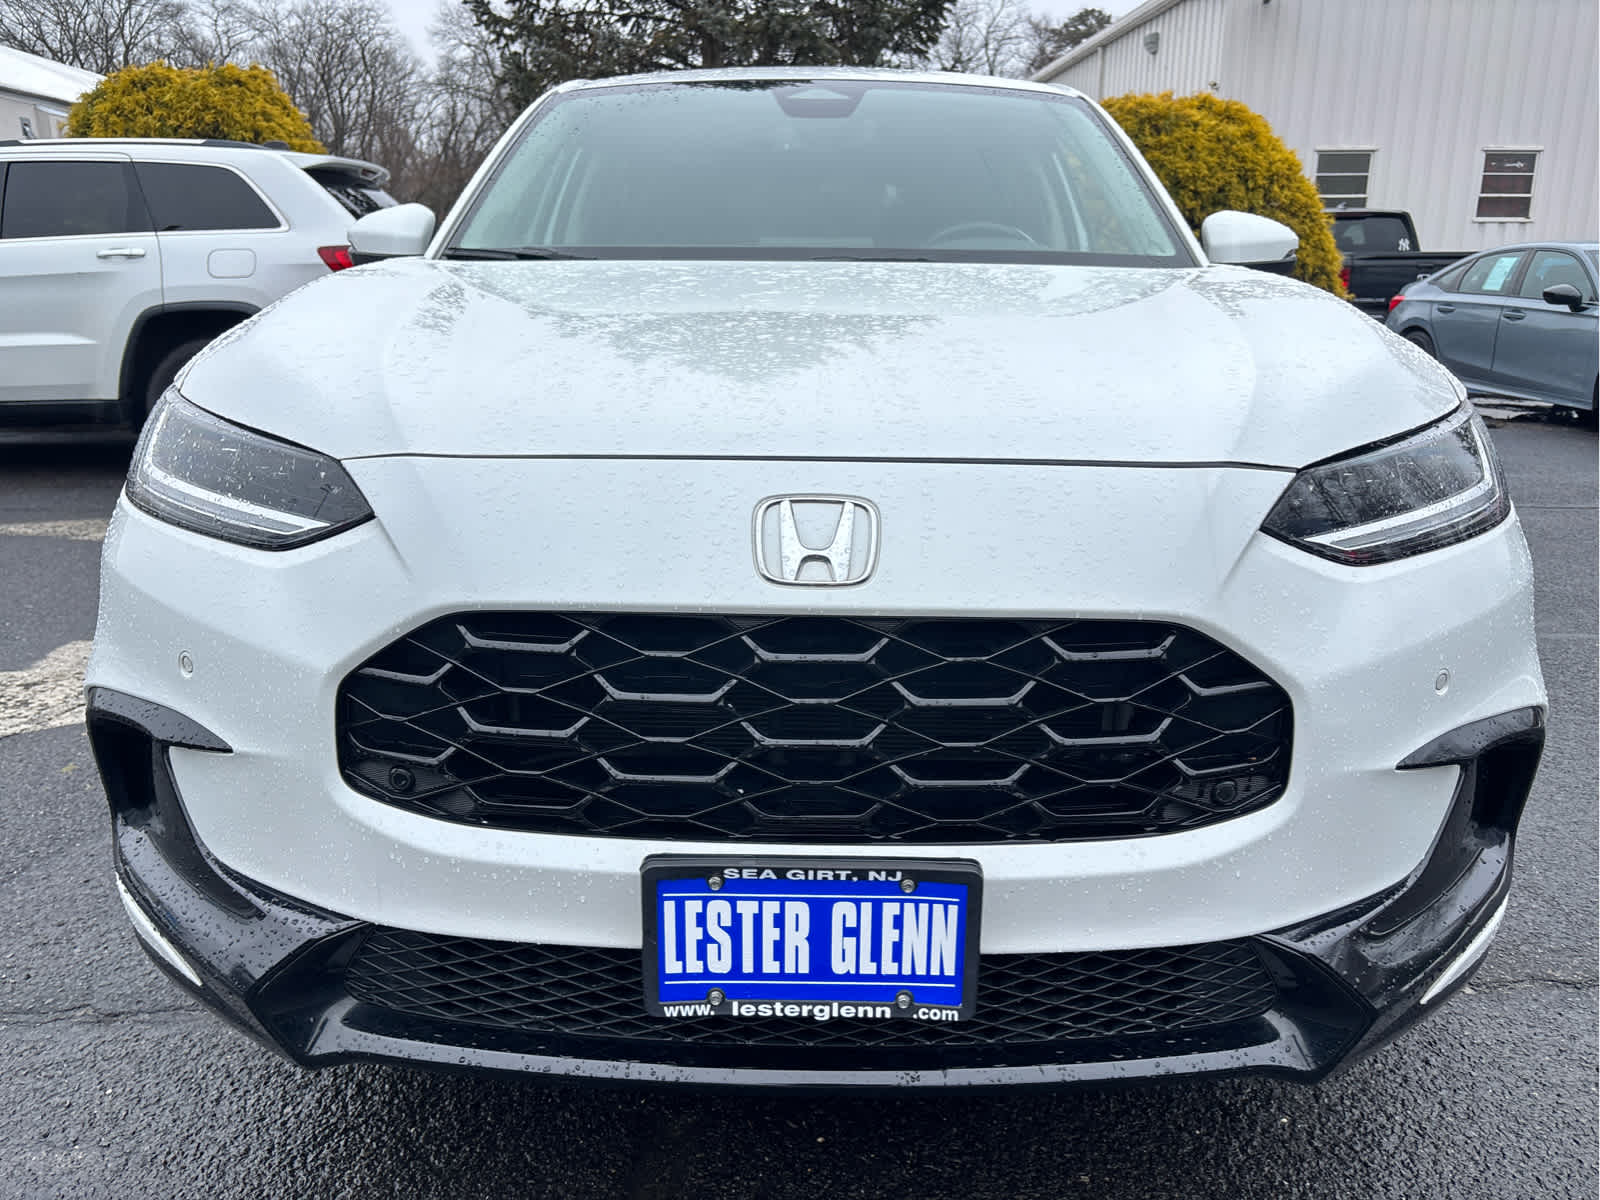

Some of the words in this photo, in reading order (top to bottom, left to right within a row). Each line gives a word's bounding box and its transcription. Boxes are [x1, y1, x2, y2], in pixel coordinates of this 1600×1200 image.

[723, 868, 777, 879] SEA
[786, 870, 858, 882] GIRT,
[868, 871, 902, 882] NJ
[663, 899, 810, 974] LESTER
[831, 901, 959, 976] GLENN
[663, 1004, 715, 1017] www.
[731, 1001, 892, 1021] lesterglenn
[912, 1007, 960, 1021] .com
